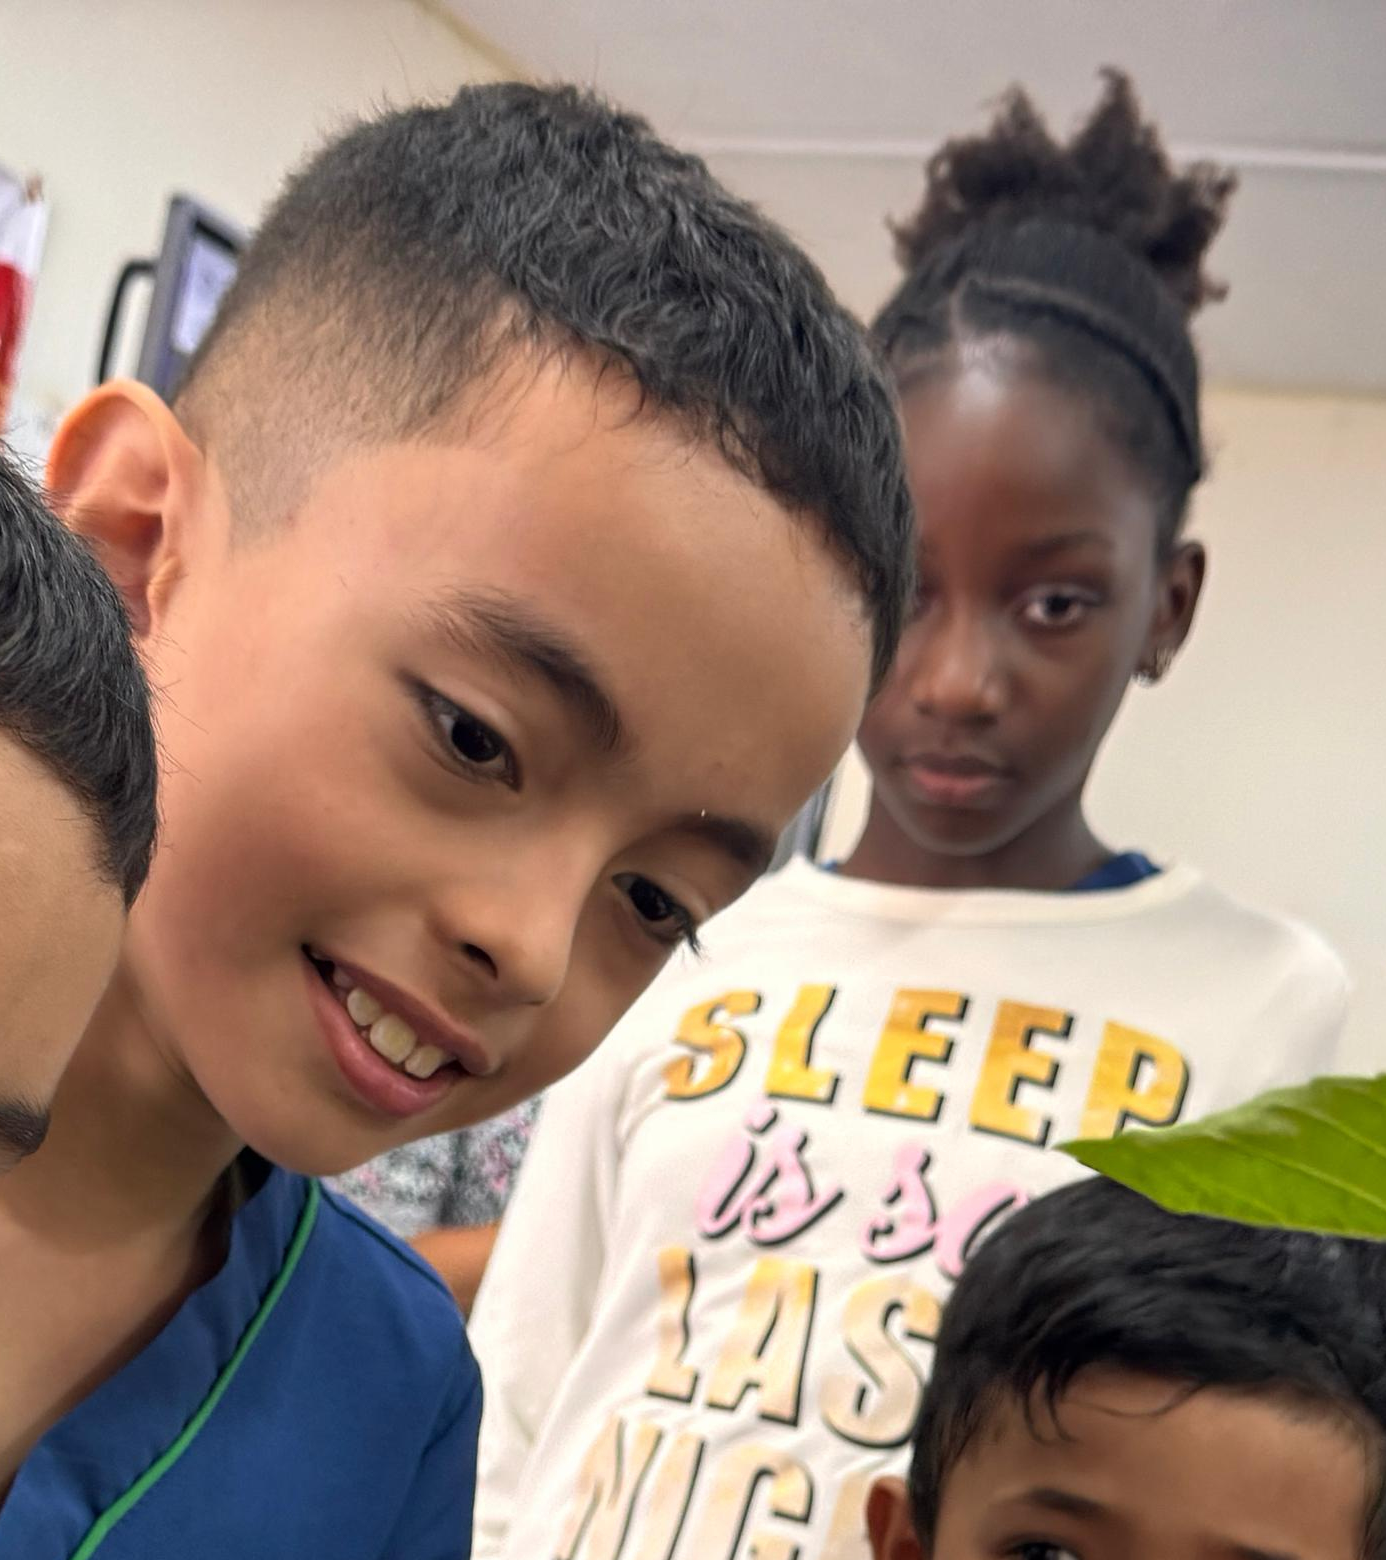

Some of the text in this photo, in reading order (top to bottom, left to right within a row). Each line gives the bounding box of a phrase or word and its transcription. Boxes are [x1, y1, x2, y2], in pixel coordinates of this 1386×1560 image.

[661, 983, 1191, 1150] SLEEP
[695, 1106, 844, 1247] is
[646, 1246, 943, 1449] LAS
